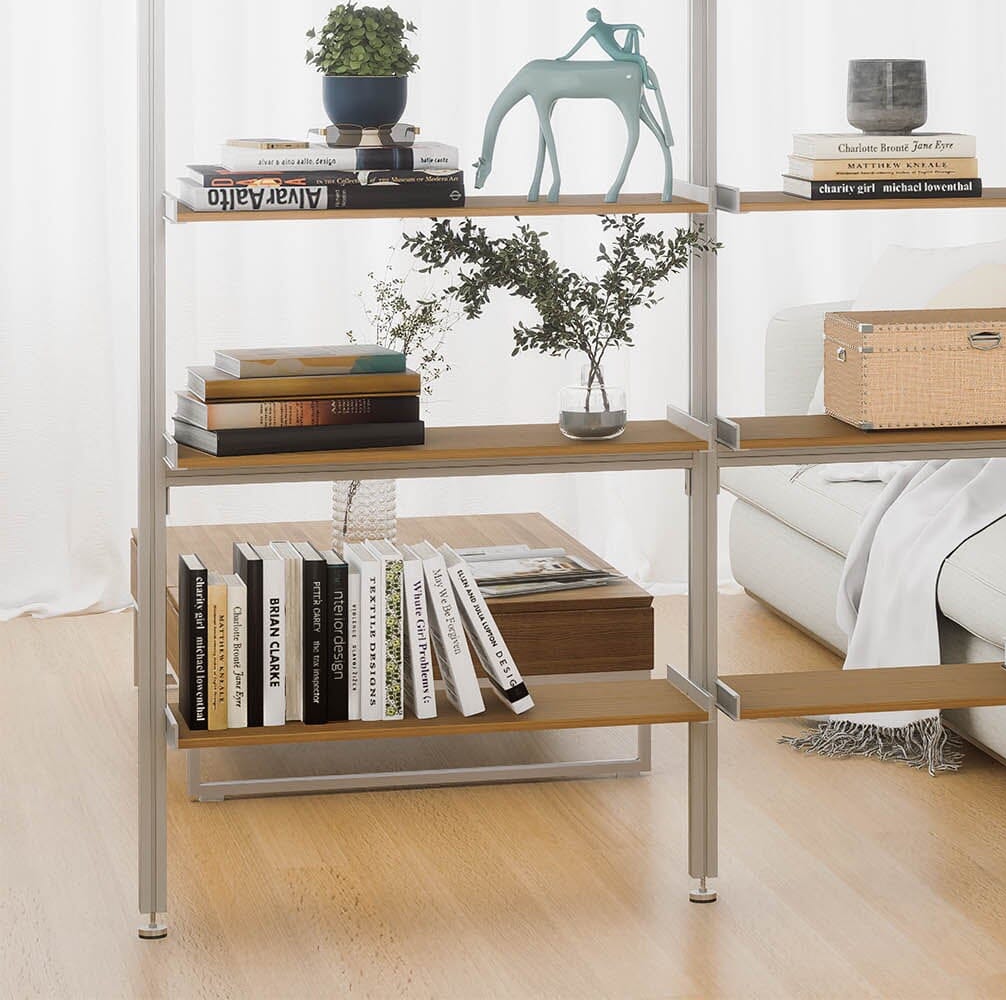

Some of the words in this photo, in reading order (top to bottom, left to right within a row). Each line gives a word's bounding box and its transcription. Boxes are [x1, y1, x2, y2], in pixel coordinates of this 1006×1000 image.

[838, 143, 878, 153] Charlotte
[880, 143, 909, 153] Brontë
[911, 140, 932, 153] Jane
[934, 140, 954, 151] Eyre
[818, 184, 855, 196] charity
[857, 183, 875, 195] girl
[882, 183, 922, 193] michael
[924, 181, 973, 192] lowenthal
[207, 188, 265, 210] Aalto
[266, 188, 322, 210] Alvar
[432, 568, 444, 590] May
[195, 576, 205, 610] charity
[312, 581, 321, 606] PETER
[438, 588, 448, 604] We
[269, 598, 280, 637] BRIAN
[441, 603, 451, 618] Be
[456, 569, 469, 589] ELLEN
[465, 585, 477, 604] AND
[472, 603, 486, 623] JULIA
[481, 620, 498, 648] LUPTON
[195, 610, 205, 630] girl
[233, 606, 242, 641] Charlotte
[312, 607, 321, 633] CAREY
[312, 640, 320, 653] the
[445, 618, 462, 656] Forgiven
[195, 636, 206, 672] michael
[269, 639, 280, 688] CLARKE
[233, 670, 244, 689] Jane
[312, 669, 320, 704] inspector
[195, 672, 206, 721] lowenthal
[234, 690, 245, 708] Eyre
